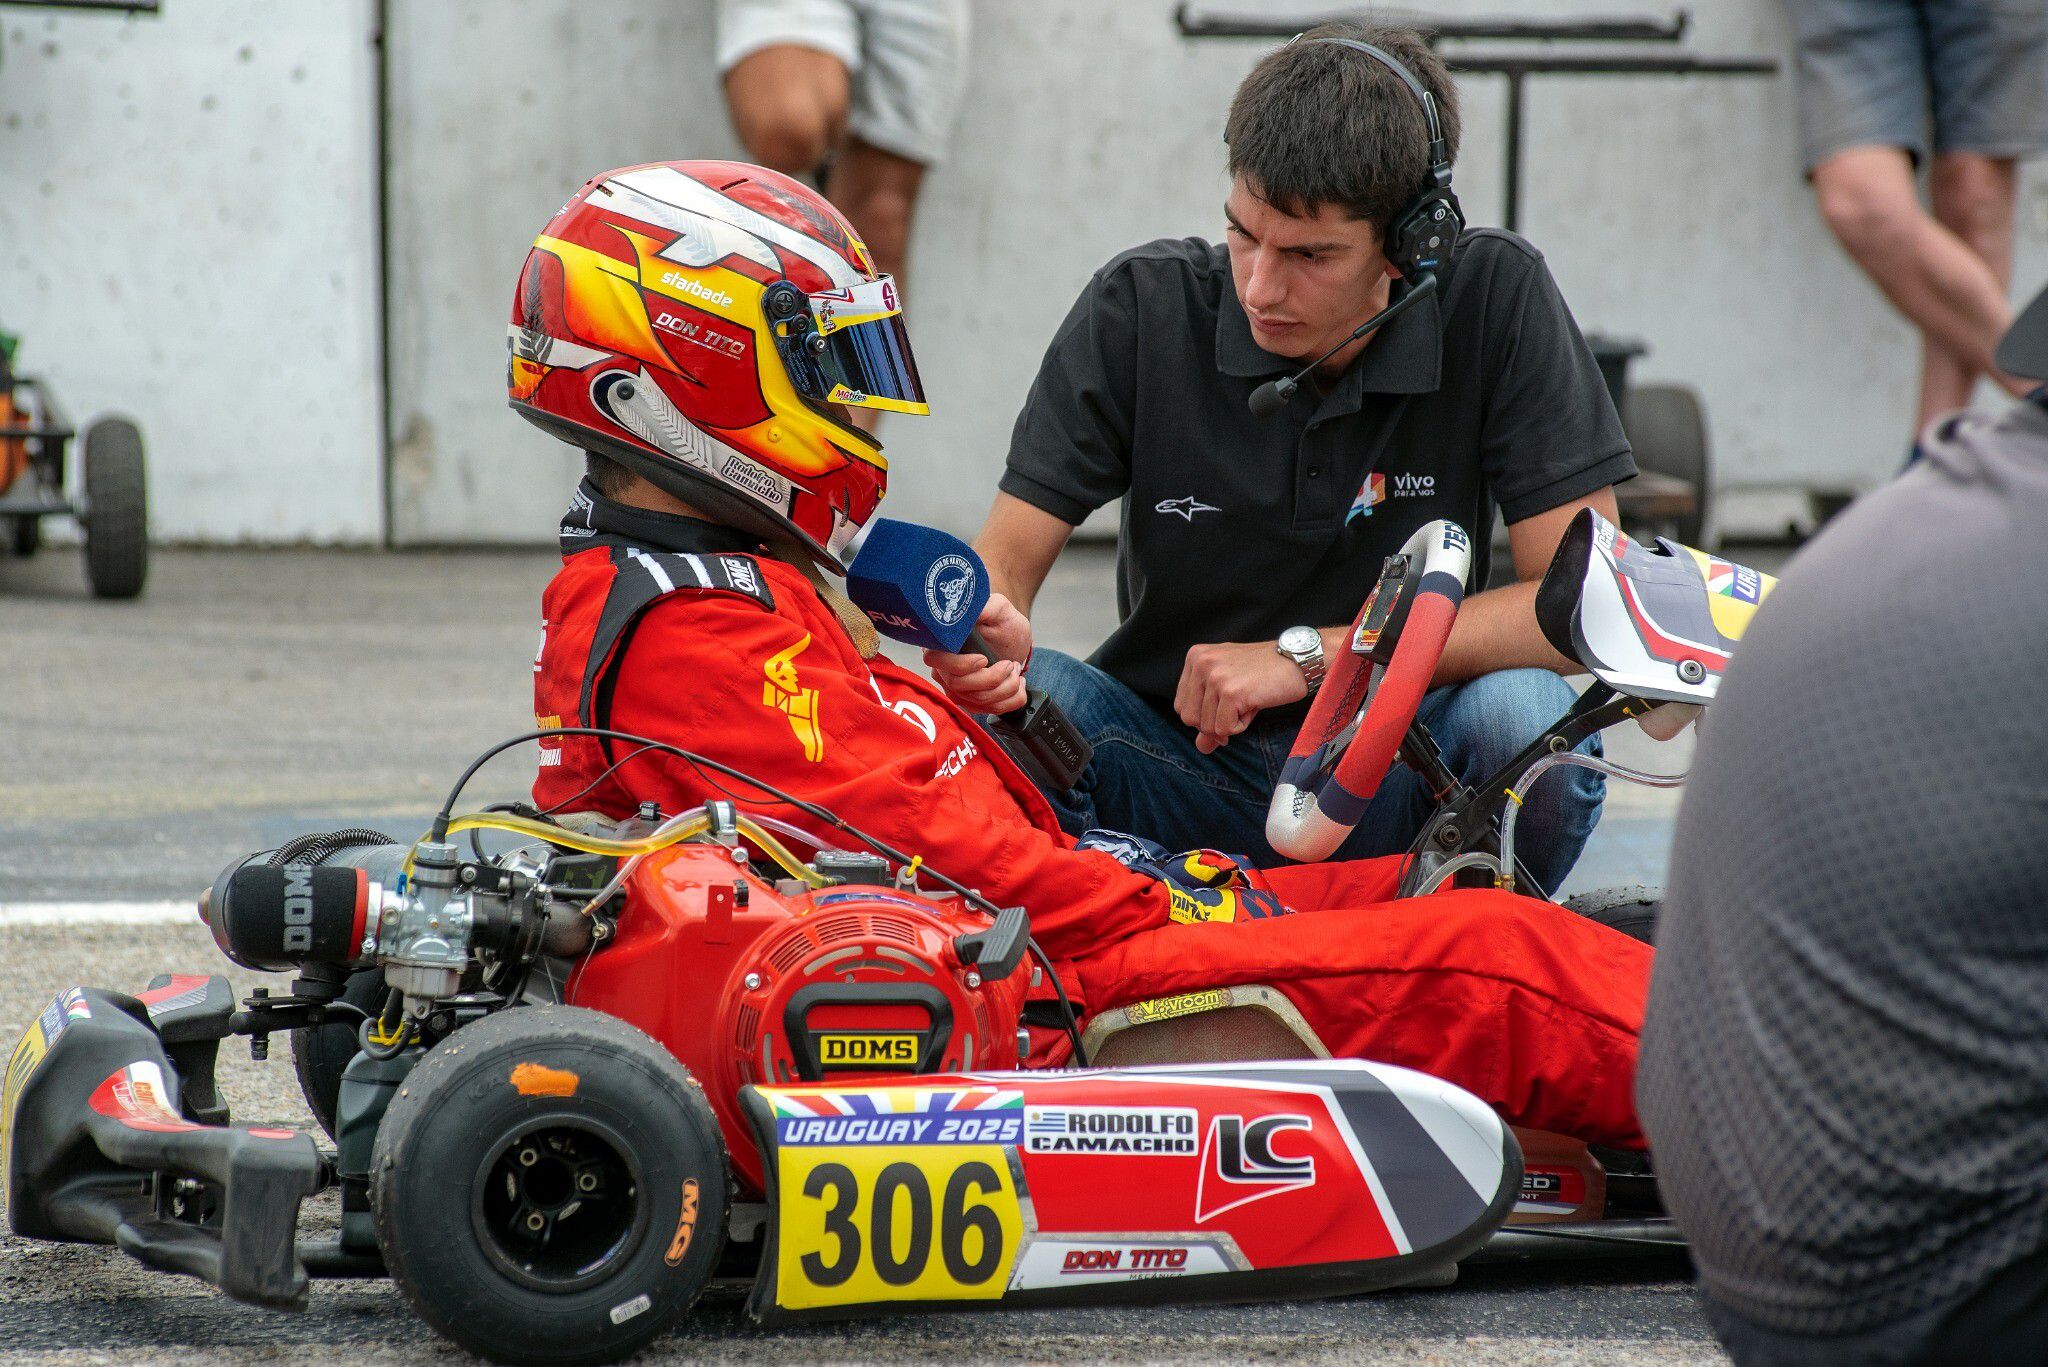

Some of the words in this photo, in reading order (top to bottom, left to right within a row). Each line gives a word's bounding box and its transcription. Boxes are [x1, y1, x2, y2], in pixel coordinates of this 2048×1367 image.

[660, 271, 734, 309] starbade
[655, 311, 700, 337] DON
[703, 329, 746, 355] TITO
[1394, 472, 1435, 489] vivo
[1394, 489, 1416, 498] para
[726, 556, 755, 593] OMP
[826, 1039, 913, 1060] DOMS
[784, 1118, 932, 1143] URUGUAY
[936, 1118, 1022, 1142] 2025
[1068, 1112, 1194, 1136] RODOLFO
[1031, 1136, 1195, 1153] CAMACHO
[1216, 1114, 1316, 1184] LC
[666, 1184, 698, 1262] MG
[800, 1160, 1004, 1288] 306
[1063, 1249, 1122, 1270] DON
[1130, 1248, 1188, 1268] TITO
